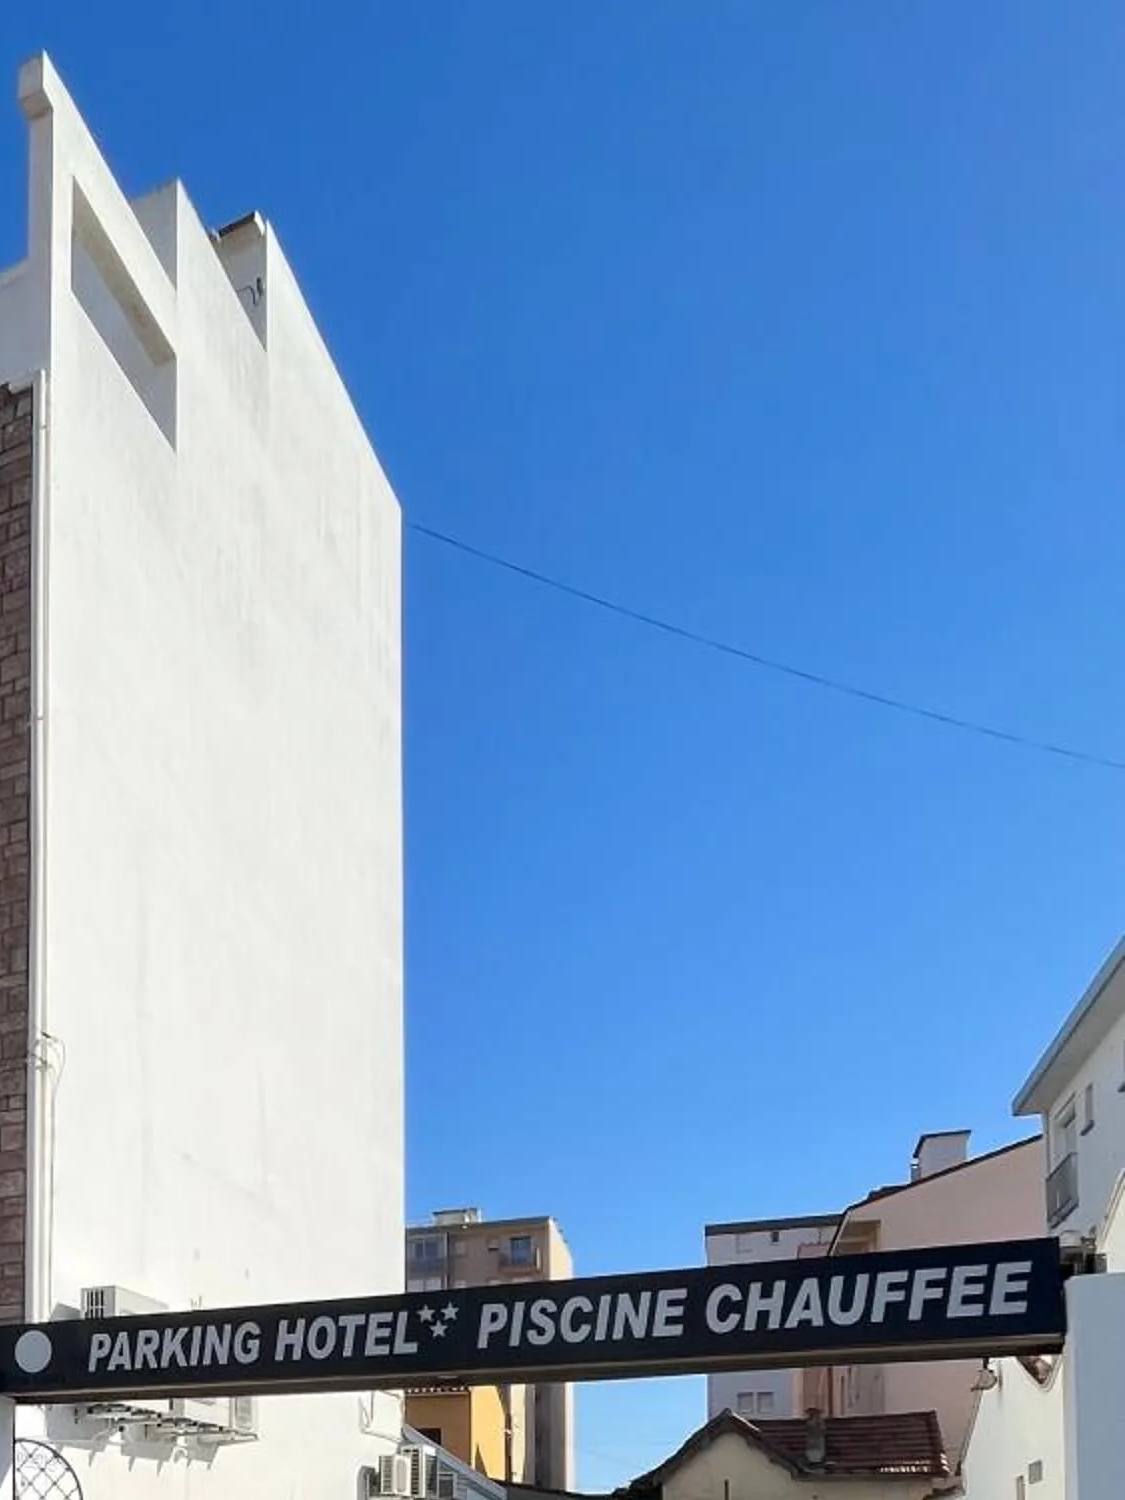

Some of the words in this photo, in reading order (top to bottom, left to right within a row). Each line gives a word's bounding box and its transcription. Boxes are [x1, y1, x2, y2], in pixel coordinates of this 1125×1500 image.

[88, 1320, 261, 1372] PARKING
[275, 1311, 418, 1361] HOTEL
[477, 1289, 688, 1349] PISCINE
[705, 1261, 1033, 1333] CHAUFFEE
